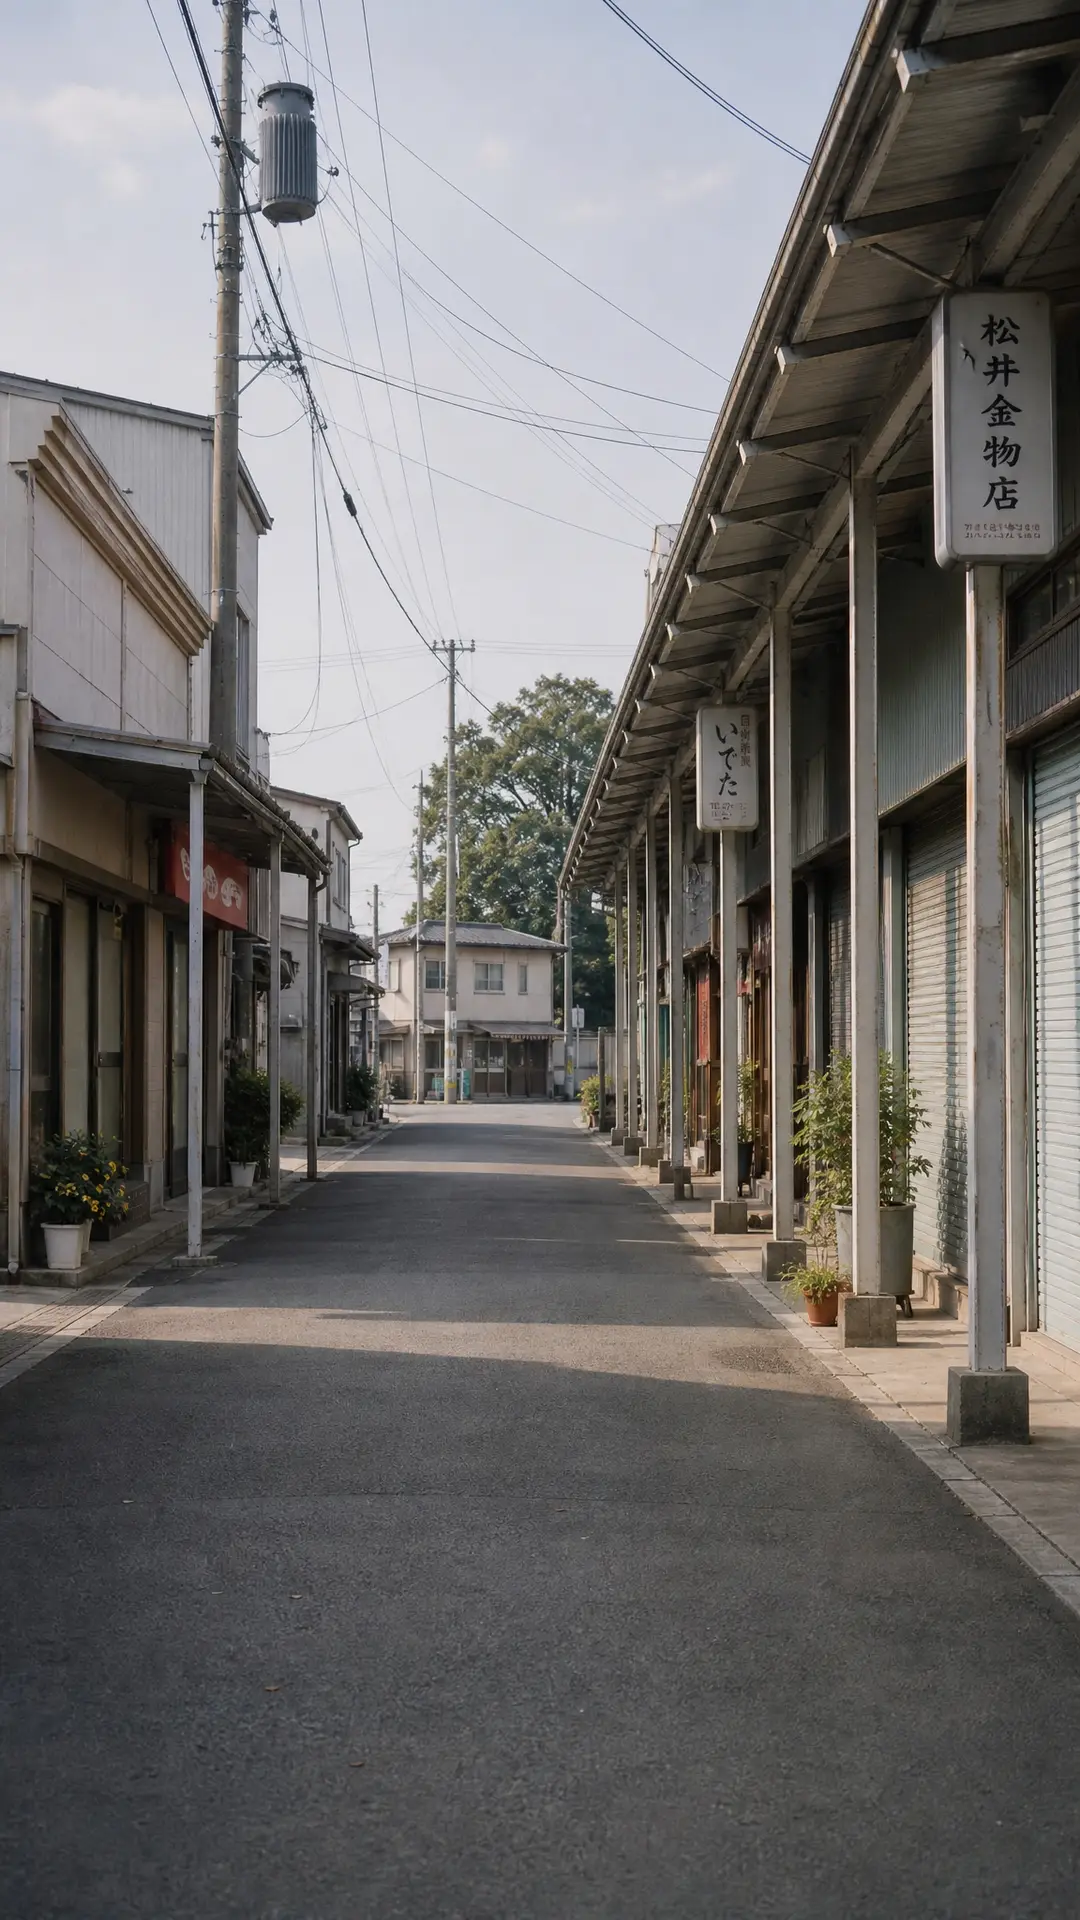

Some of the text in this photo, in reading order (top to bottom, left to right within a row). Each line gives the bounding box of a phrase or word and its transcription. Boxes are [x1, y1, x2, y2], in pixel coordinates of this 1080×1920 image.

[980, 313, 1023, 511] 松井金物店
[715, 722, 738, 796] いでた
